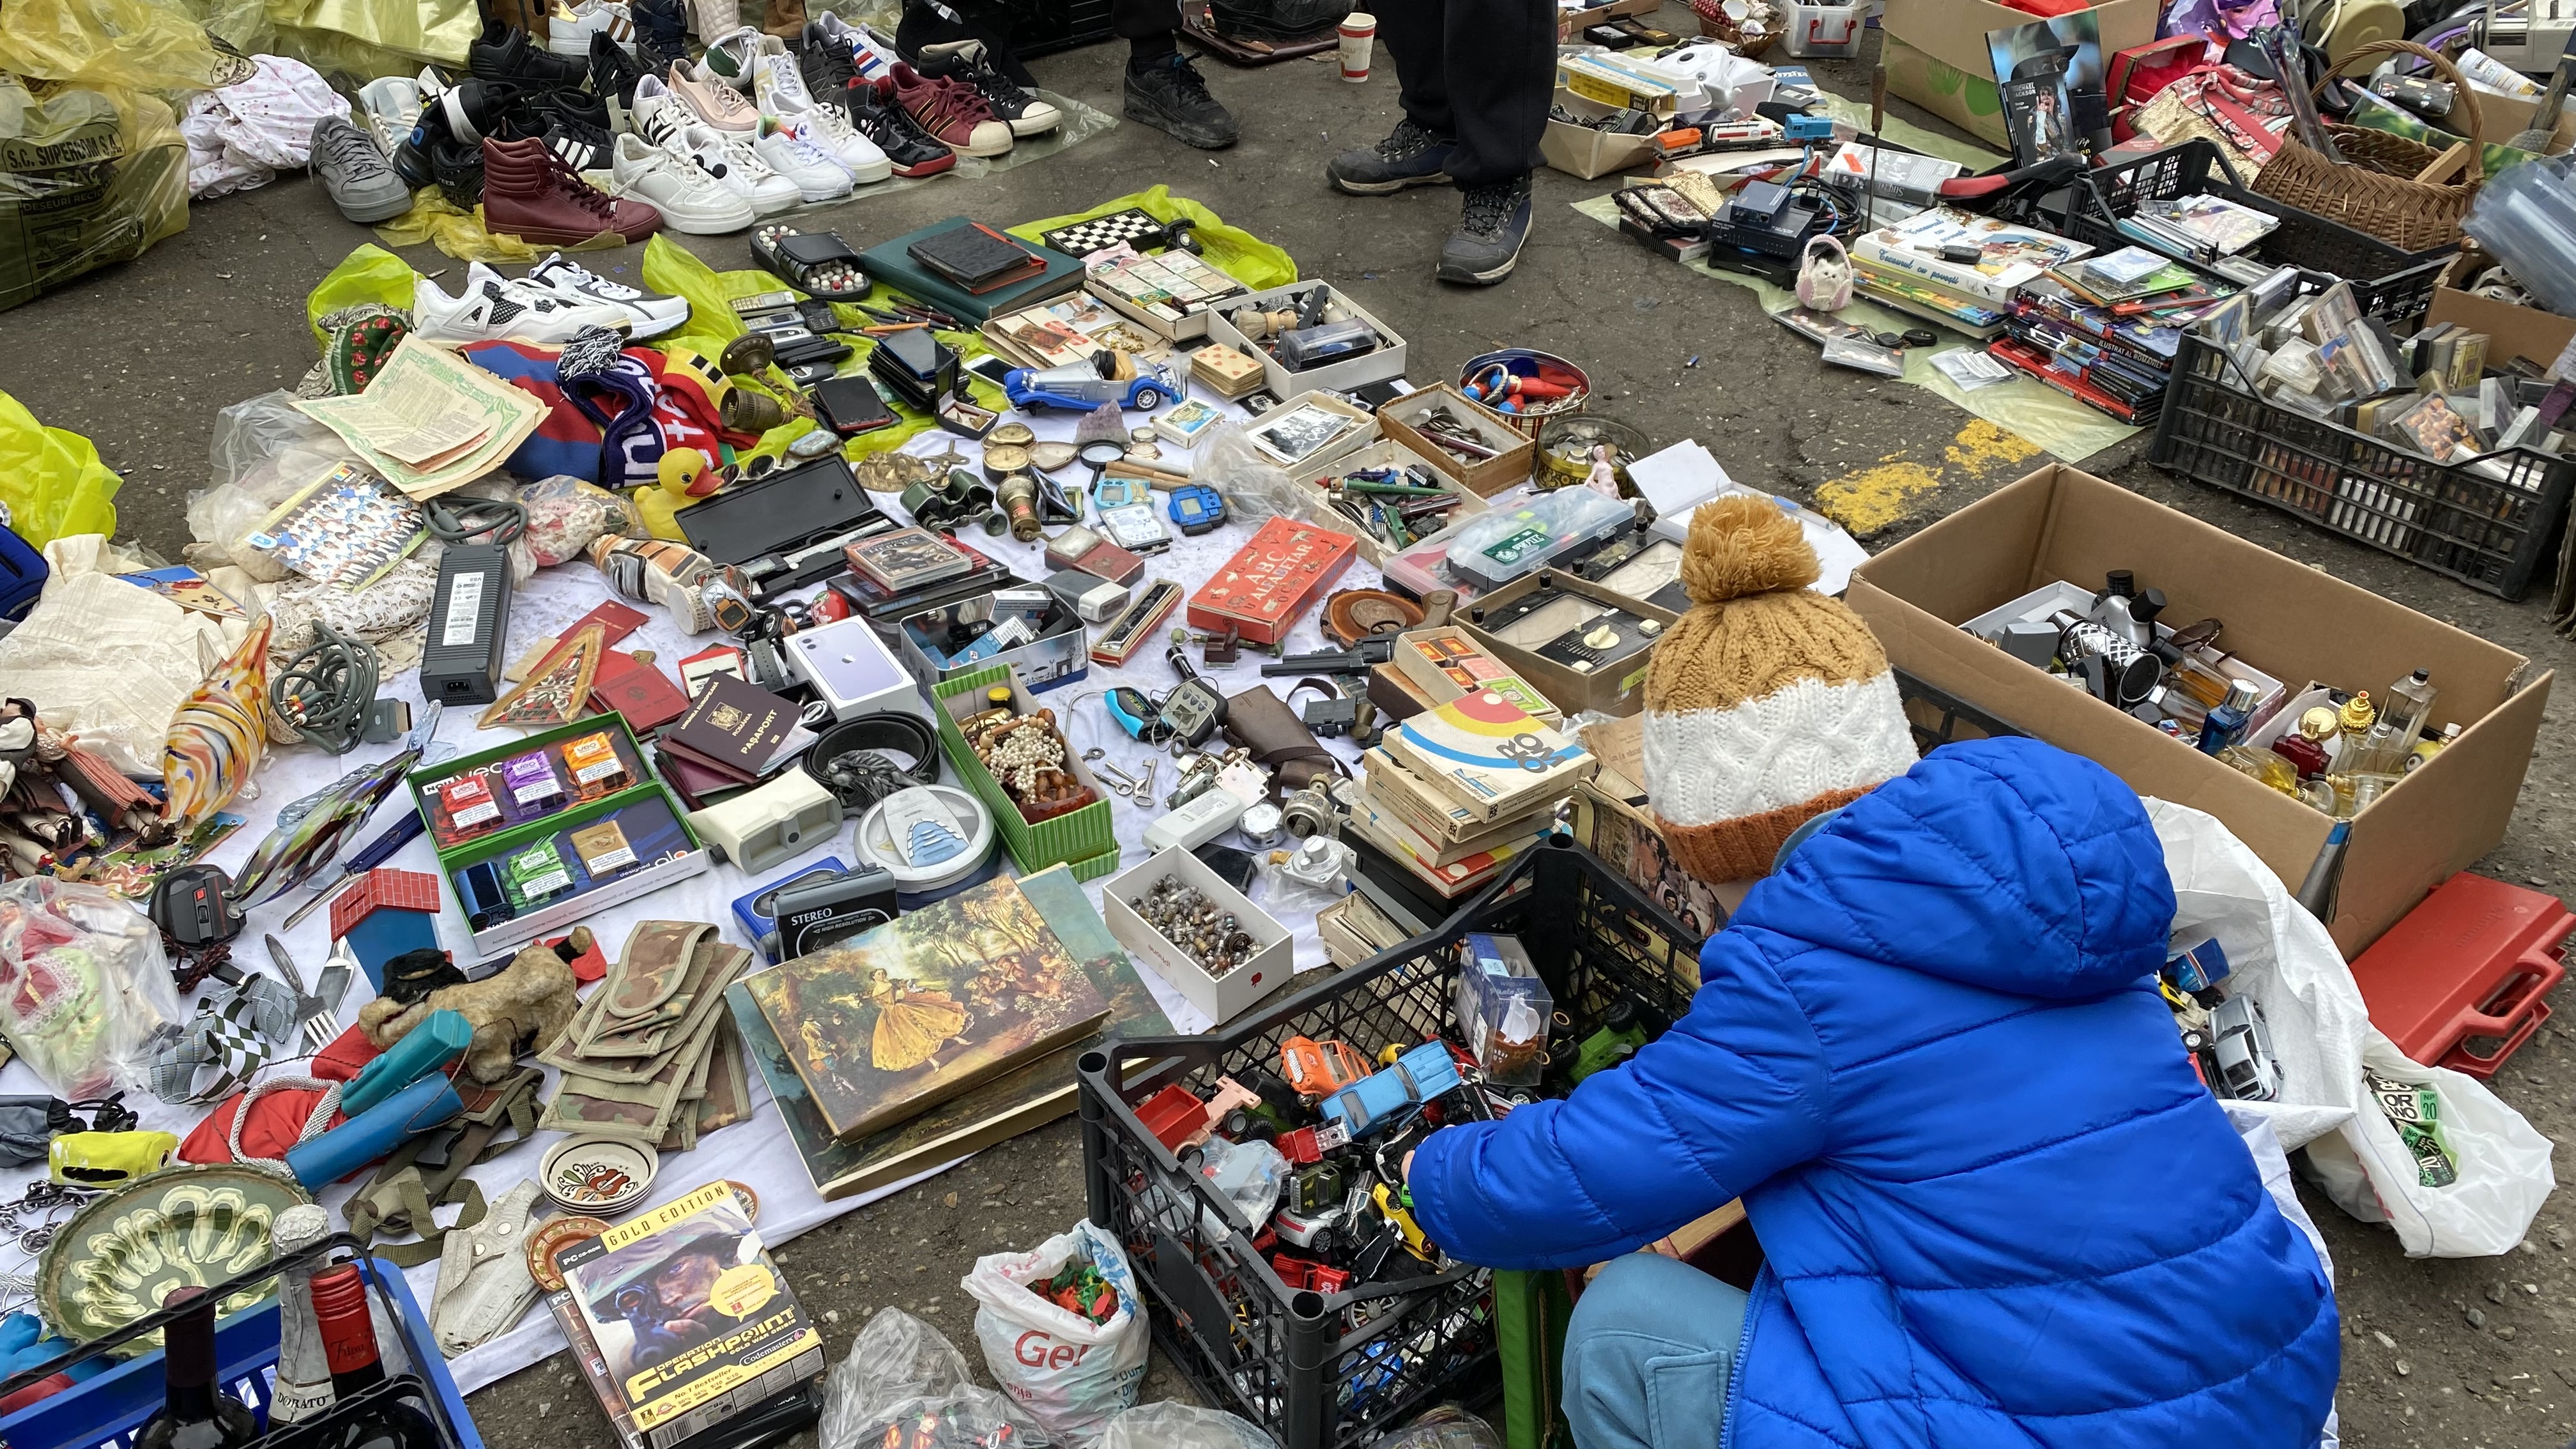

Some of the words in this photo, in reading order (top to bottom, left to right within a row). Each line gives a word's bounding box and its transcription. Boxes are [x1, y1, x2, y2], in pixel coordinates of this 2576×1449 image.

[576, 743, 597, 753] veo
[516, 761, 536, 770] veo
[454, 785, 475, 793] veo
[791, 908, 832, 926] STEREO
[835, 917, 866, 929] RESOLUTION
[2423, 1103, 2437, 1120] 20
[608, 1220, 651, 1246] GOLD
[659, 1186, 724, 1223] EDITION
[562, 1254, 578, 1266] PC
[729, 1344, 751, 1355] COLD
[751, 1333, 770, 1345] WAR
[770, 1319, 797, 1335] CRISIS
[625, 1310, 795, 1404] FLASHPOINT
[657, 1337, 721, 1371] OPERATION
[744, 1336, 793, 1365] Codemasters
[694, 1368, 732, 1390] Bestseller
[277, 1392, 326, 1409] DORATO
